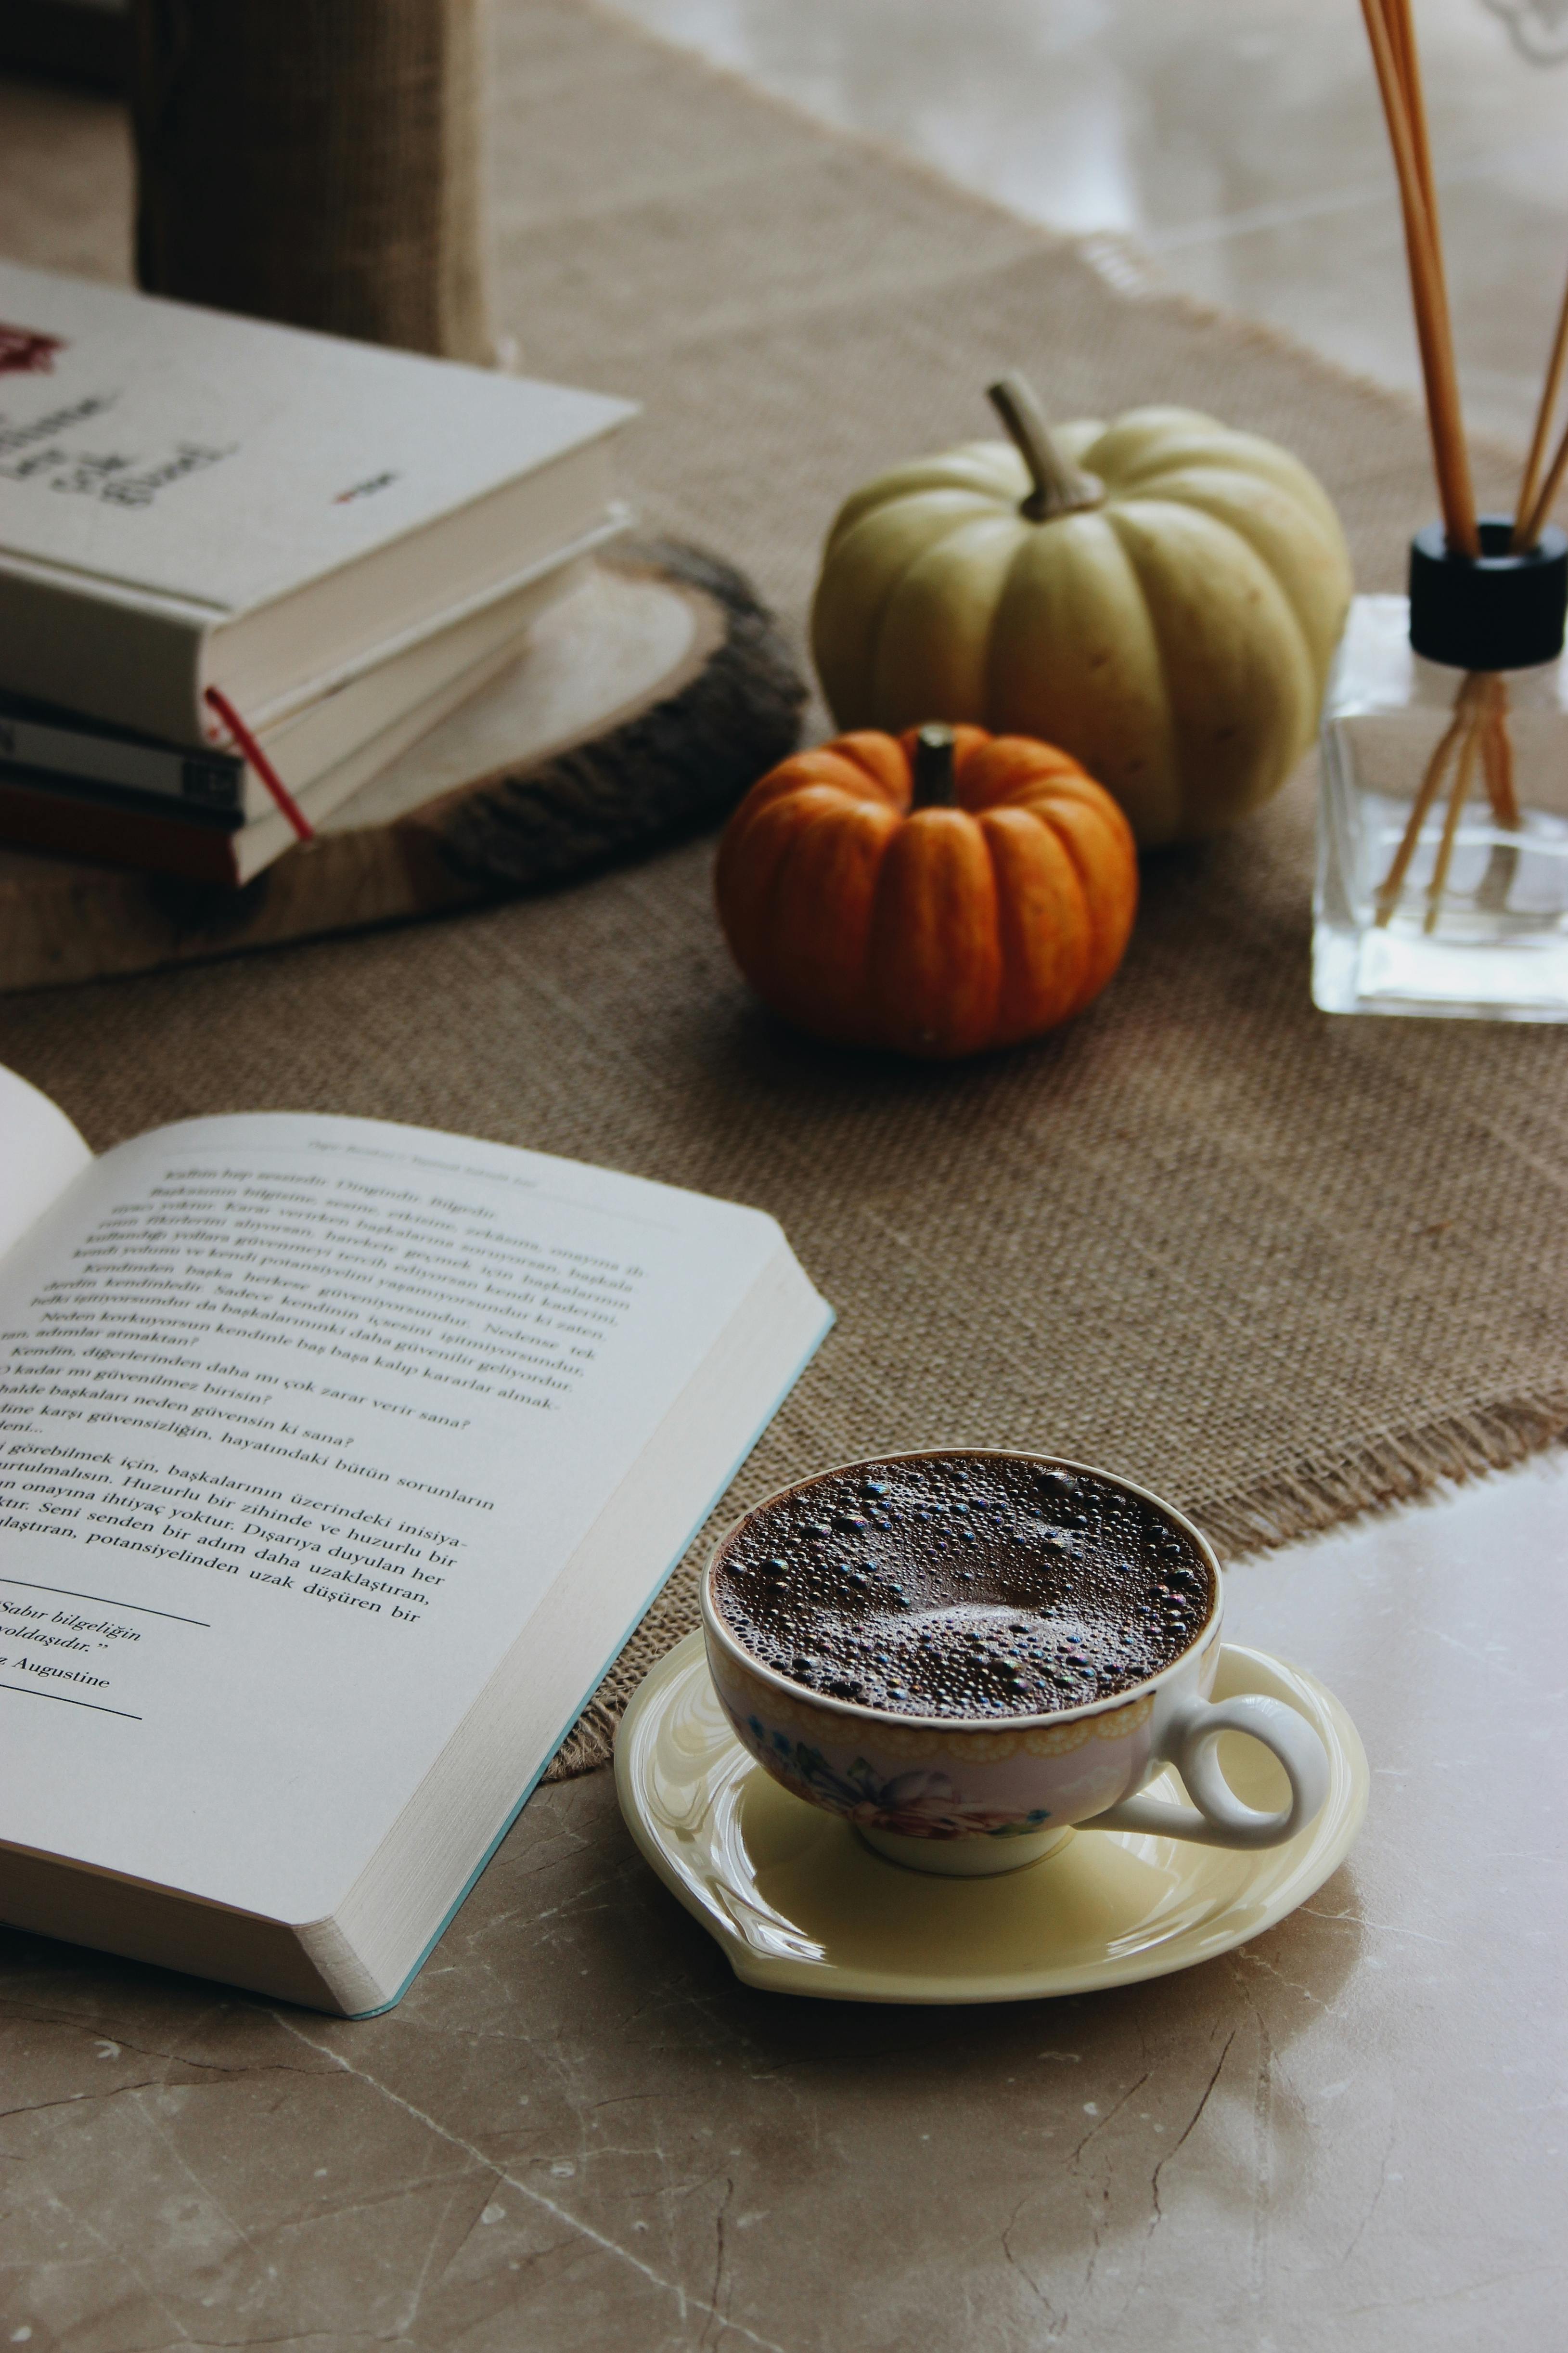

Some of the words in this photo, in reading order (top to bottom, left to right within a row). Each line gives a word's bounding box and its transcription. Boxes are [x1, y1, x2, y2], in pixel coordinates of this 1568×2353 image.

[36, 1327, 102, 1337] adımlar
[106, 1330, 199, 1346] atmaktan?
[41, 1311, 95, 1321] Neden
[100, 1311, 210, 1331] korkuyorsun
[215, 1323, 292, 1345] kendinle
[297, 1338, 326, 1355] baş
[330, 1345, 369, 1363] başa
[374, 1356, 418, 1376] kalıp
[423, 1368, 491, 1393] kararlar
[11, 1345, 75, 1357] Kendin,
[82, 1346, 201, 1369] diğerlerinden
[206, 1362, 249, 1378] daha
[255, 1374, 279, 1384] mı
[284, 1381, 314, 1392] çok
[321, 1388, 366, 1404] zarar
[373, 1400, 412, 1415] verir
[419, 1412, 471, 1429] sana?
[14, 1364, 62, 1375] kadar
[67, 1369, 91, 1377] mı
[93, 1370, 198, 1390] güvenilmez
[203, 1383, 272, 1404] birisin?
[49, 1385, 129, 1402] başkaları
[133, 1396, 188, 1411] neden
[191, 1408, 275, 1429] güvensin
[280, 1422, 299, 1435] ki
[302, 1431, 354, 1448] sana?
[7, 1444, 113, 1464] görebilmek
[120, 1457, 158, 1473] için,
[168, 1464, 283, 1500] başkalarının
[291, 1494, 392, 1527] üzerindeki
[398, 1522, 467, 1547] inisiya-
[39, 1405, 83, 1420] karşı
[87, 1412, 211, 1440] güvensizliğin,
[220, 1432, 329, 1465] hayatındaki
[335, 1459, 389, 1481] bütün
[397, 1478, 494, 1510] sorunların
[22, 1484, 95, 1500] onayına
[101, 1493, 166, 1515] ihtiyaç
[168, 1509, 234, 1530] yoktur.
[242, 1523, 321, 1552] Dışarıya
[328, 1546, 405, 1575] duyulan
[411, 1567, 445, 1585] her
[39, 1502, 82, 1517] Seni
[87, 1513, 154, 1532] senden
[162, 1525, 191, 1539] bir
[197, 1537, 245, 1554] adım
[254, 1549, 300, 1568] daha
[309, 1564, 429, 1605] uzaklaştıran,
[122, 1476, 200, 1500] Huzurlu
[207, 1493, 236, 1508] bir
[241, 1504, 312, 1527] zihinde
[321, 1524, 340, 1535] ve
[347, 1528, 421, 1557] huzurlu
[429, 1551, 457, 1566] bir
[85, 1533, 239, 1574] potansiyelinden
[249, 1571, 295, 1589] uzak
[303, 1583, 381, 1612] düşüren
[391, 1605, 420, 1622] bir
[51, 1611, 141, 1641] bilgeliğin
[12, 1657, 110, 1688] Augustine
